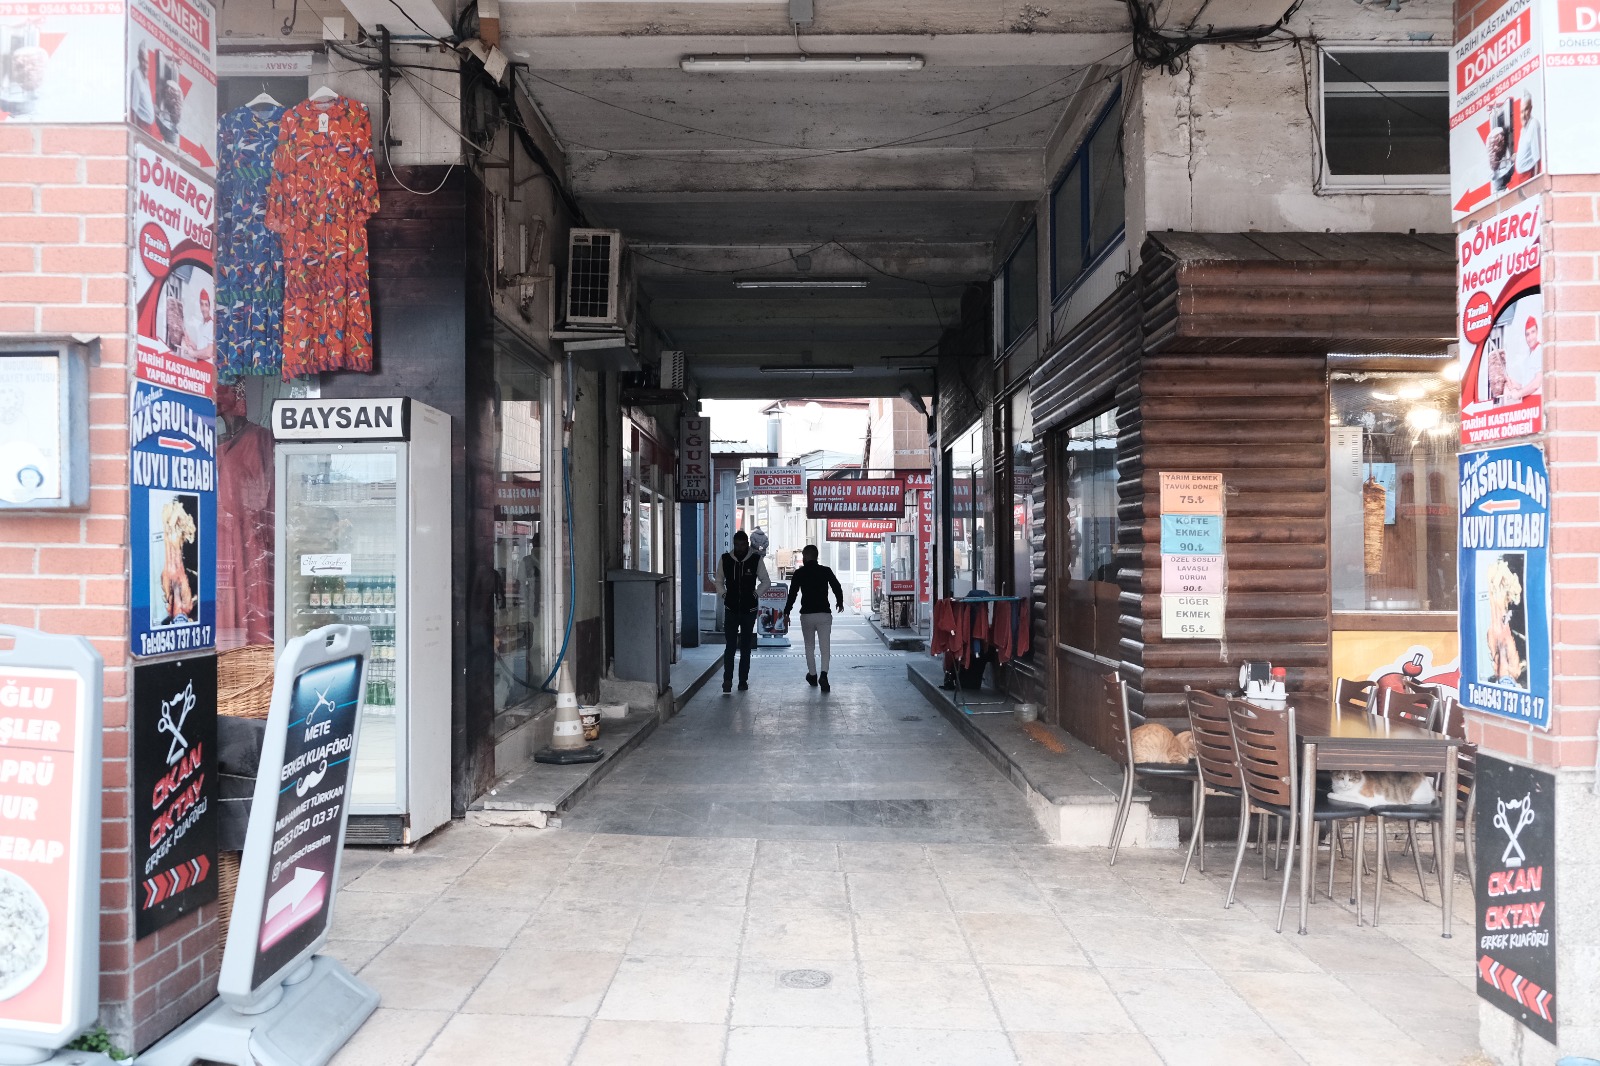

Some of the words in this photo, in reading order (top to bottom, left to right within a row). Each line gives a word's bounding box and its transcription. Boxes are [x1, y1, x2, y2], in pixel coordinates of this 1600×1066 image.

[39, 4, 68, 14] 0546
[70, 4, 91, 14] 943
[93, 4, 106, 14] 79
[108, 3, 121, 13] 96
[1576, 7, 1600, 30] D
[1465, 18, 1521, 87] DÖNERİ
[1547, 55, 1575, 65] 0546
[1577, 54, 1598, 65] 943
[140, 156, 213, 220] DÖNERCİ
[140, 190, 181, 231] Necati
[184, 216, 212, 248] Usta
[144, 233, 167, 252] Tarihi
[1462, 205, 1540, 267] DÖNERCİ
[144, 247, 169, 267] Lezzet
[1462, 254, 1502, 293] Necati
[1506, 244, 1540, 275] Usta
[1467, 302, 1489, 318] Tarihi
[1467, 314, 1492, 331] Lezzet
[138, 351, 164, 370] TARİHİ
[166, 359, 211, 383] KASTAMONU
[146, 367, 177, 385] YAPRAK
[178, 377, 205, 395] DÖNERİ
[132, 401, 214, 458] NASRULLAH
[280, 405, 393, 430] BAYSAN
[1462, 414, 1487, 431] TARİHİ
[1488, 406, 1540, 426] KASTAMONU
[1469, 427, 1499, 442] YAPRAK
[1501, 419, 1533, 436] DÖNERİ
[685, 421, 703, 474] UĞUR
[133, 450, 169, 488] KUYU
[172, 455, 214, 491] KEBABI
[760, 475, 796, 485] DÖNERİ
[681, 489, 707, 497] GIDA
[813, 483, 852, 496] SARIOĞLU
[856, 485, 900, 498] KARDEŞLER
[1462, 459, 1547, 515] NASRULLAH
[813, 503, 833, 511] KUYU
[834, 503, 860, 511] KEBABI
[862, 503, 868, 511] &
[869, 503, 897, 511] KASABI
[1176, 516, 1209, 525] KÖFTE
[862, 522, 893, 530] KARDEŞLER
[1175, 529, 1210, 537] EKMEK
[1462, 516, 1495, 548] KUYU
[1497, 513, 1545, 548] KEBABI
[1178, 596, 1209, 605] CİĞER
[140, 630, 175, 655] Tel:0543
[177, 628, 190, 649] 737
[192, 627, 200, 646] 13
[202, 626, 210, 645] 17
[1469, 684, 1501, 710] Tel:0543
[1502, 691, 1519, 713] 737
[1520, 694, 1531, 717] 13
[1532, 697, 1544, 719] 17
[304, 720, 331, 742] METE
[0, 755, 55, 786] PRÜ
[281, 753, 307, 781] ERKEK
[306, 733, 352, 766] KUAFÖRÜ
[152, 742, 202, 810] OKAN
[0, 795, 39, 820] UR
[150, 773, 205, 849] OKTAY
[275, 798, 310, 832] MUHAMMET
[311, 785, 344, 807] TÜRKKAN
[273, 829, 294, 855] 0553
[293, 818, 310, 839] 050
[312, 810, 326, 827] 03
[326, 804, 340, 821] 37
[1488, 866, 1542, 897] OKAN
[1485, 901, 1546, 931] OKTAY
[1481, 933, 1509, 950] ERKEK
[1509, 929, 1549, 950] KUAFÖRÜ
